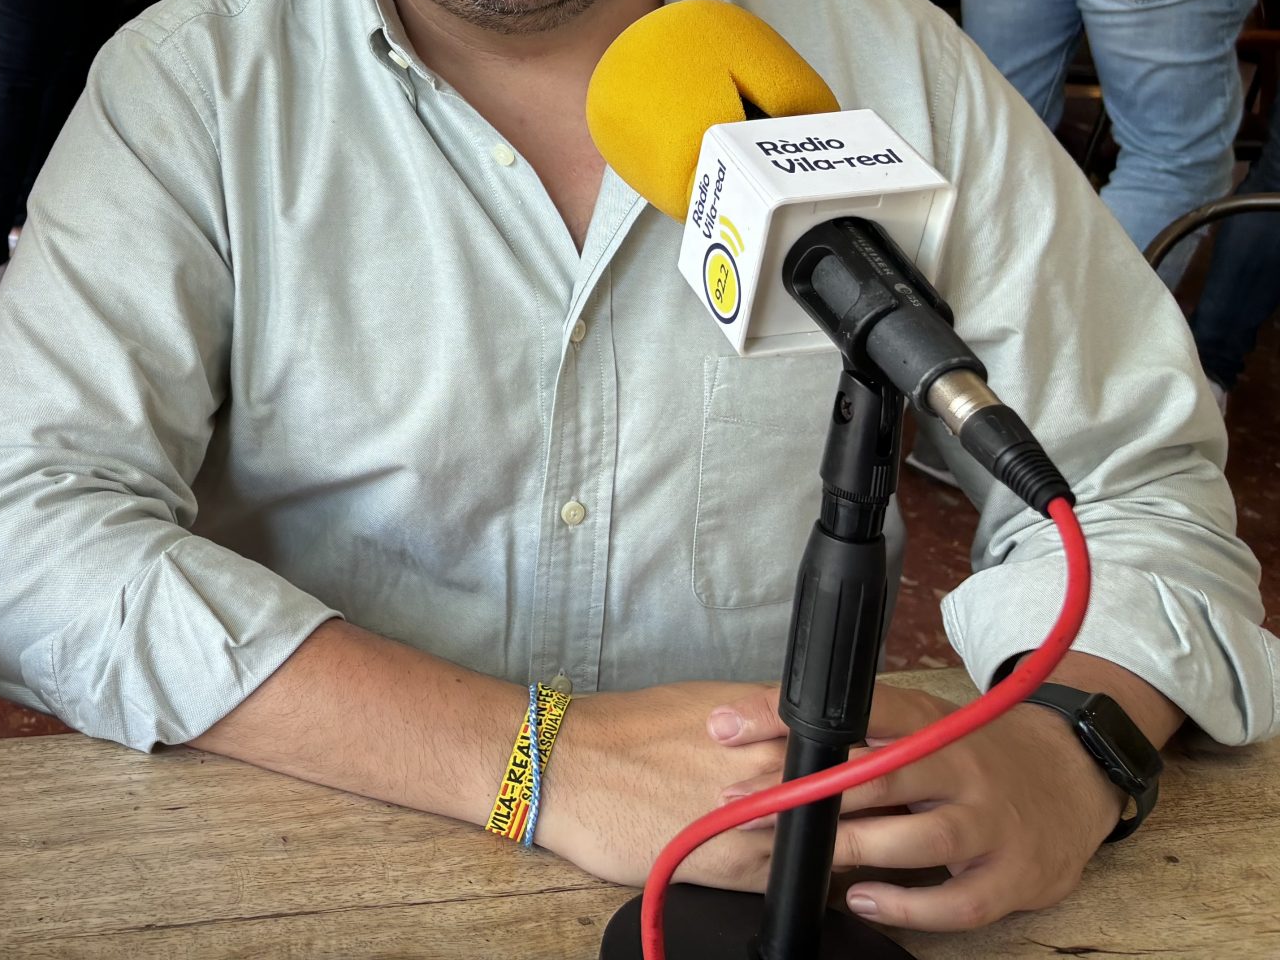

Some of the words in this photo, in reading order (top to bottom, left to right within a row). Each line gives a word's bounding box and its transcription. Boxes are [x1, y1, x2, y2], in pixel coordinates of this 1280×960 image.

[755, 137, 845, 156] Ràdio
[771, 148, 903, 173] Vila-real
[692, 173, 710, 228] Ràdio
[703, 158, 727, 239] Vila-real
[715, 264, 729, 303] 92.2
